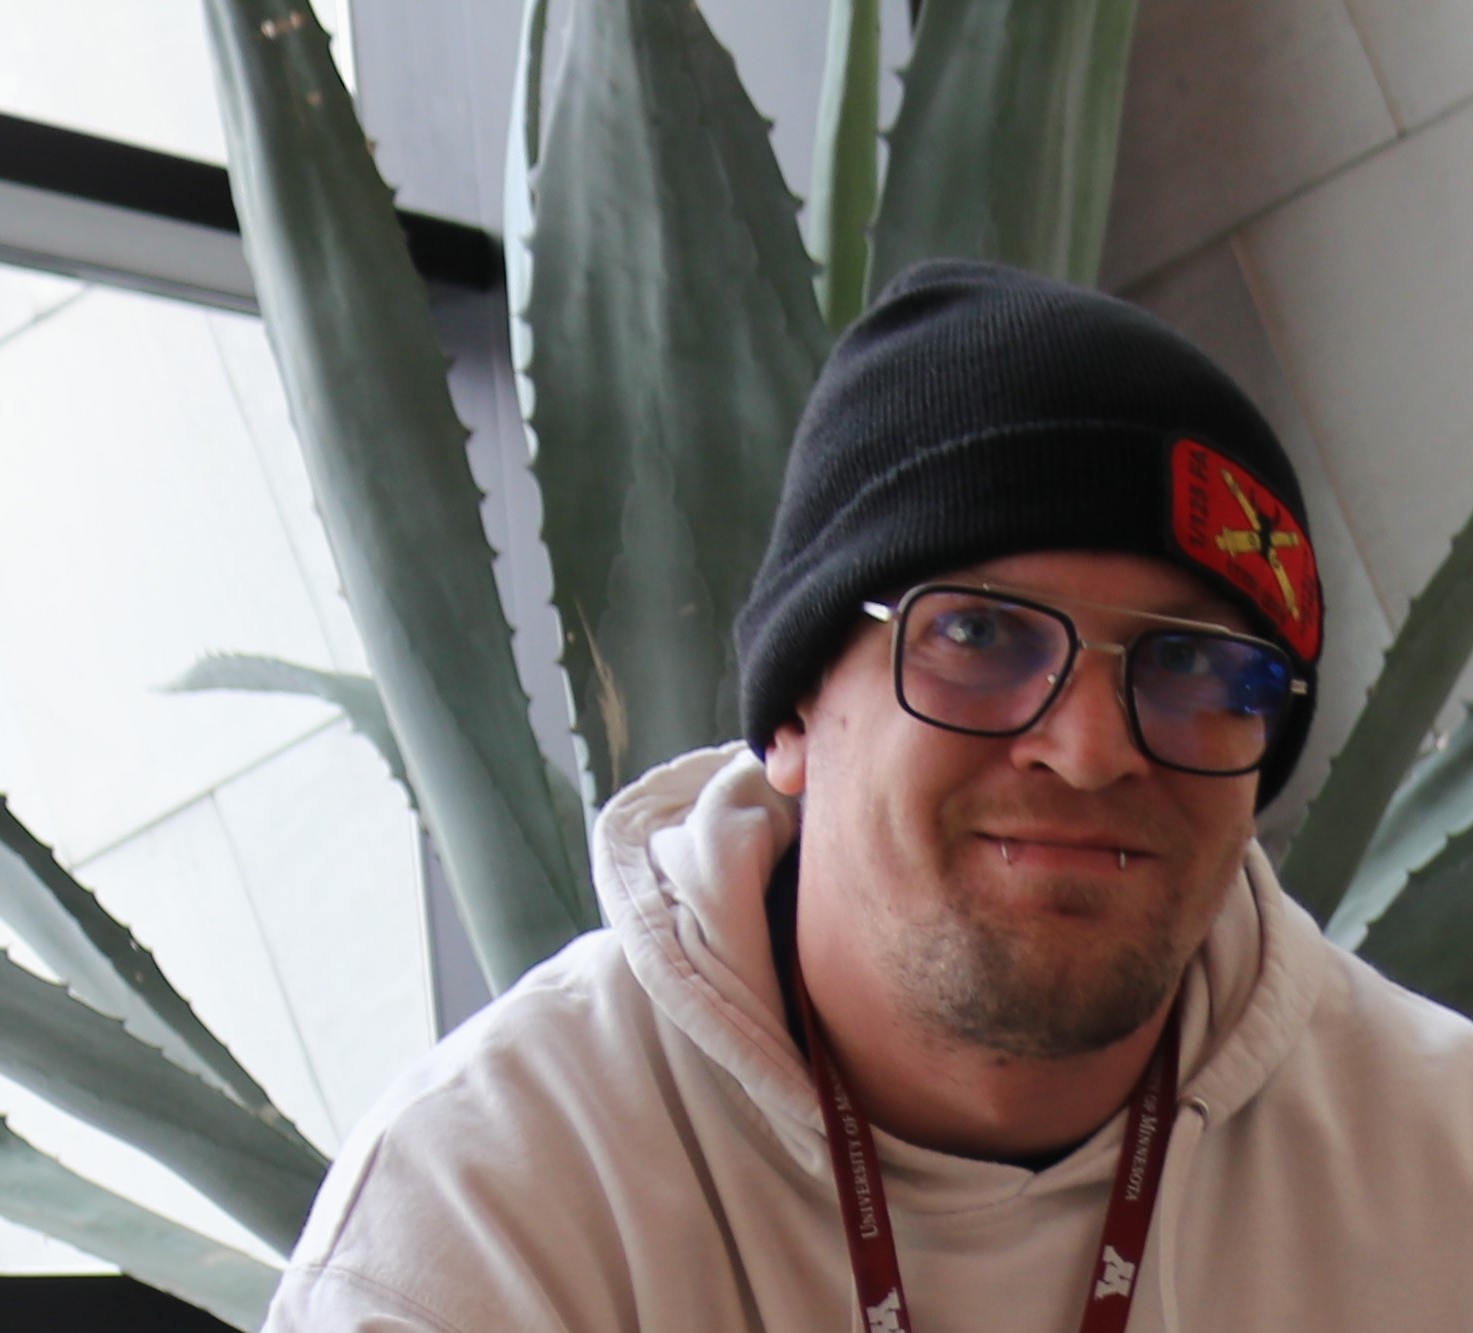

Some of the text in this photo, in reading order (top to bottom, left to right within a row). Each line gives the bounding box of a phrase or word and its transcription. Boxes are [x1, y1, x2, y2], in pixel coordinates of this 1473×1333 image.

[842, 1115, 879, 1239] UNIVERSITY OF
[1125, 1114, 1157, 1201] MINNESOTA
